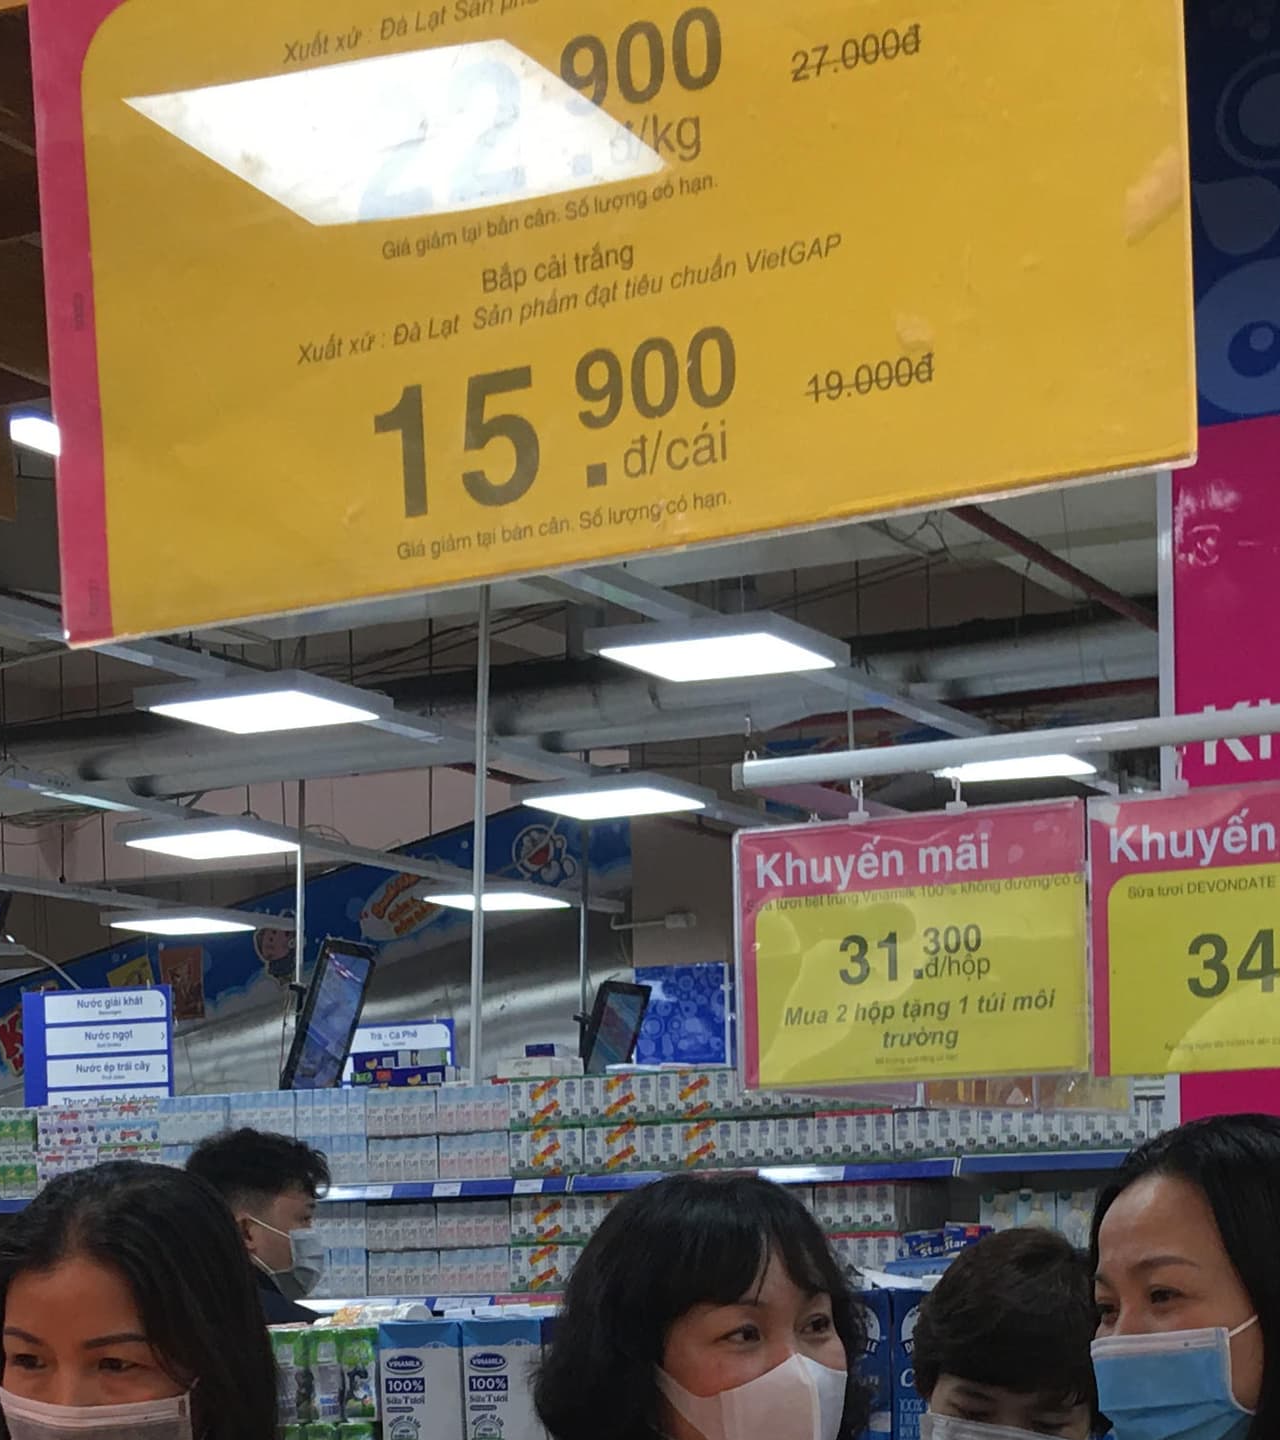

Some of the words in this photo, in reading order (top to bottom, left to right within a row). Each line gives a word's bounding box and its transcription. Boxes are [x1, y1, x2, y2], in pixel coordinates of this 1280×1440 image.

[560, 6, 722, 117] 900
[790, 22, 922, 84] 27.000đ
[382, 231, 412, 260] Giá
[415, 222, 458, 257] giảm
[564, 193, 589, 221] Số
[593, 185, 648, 218] lượng
[651, 180, 675, 202] có
[481, 260, 528, 294] Bắp
[533, 252, 568, 284] cải
[574, 240, 635, 280] trắng
[296, 332, 343, 366] Xuất
[348, 328, 376, 355] xứ
[393, 321, 421, 346] Đà
[428, 313, 461, 337] Lạt
[472, 300, 513, 331] Sản
[519, 288, 578, 324] phẩm
[584, 281, 618, 310] đạt
[624, 269, 662, 301] tiêu
[669, 252, 736, 291] chuẩn
[744, 234, 842, 273] VietGAP
[574, 325, 737, 430] 900
[804, 352, 935, 404] 19.000đ
[622, 418, 729, 479] đ/cái
[396, 535, 426, 562] Giá
[430, 528, 472, 560] giảm
[476, 526, 496, 551] tại
[578, 501, 604, 530] Số
[607, 499, 662, 531] lượng
[666, 492, 688, 516] có
[755, 835, 905, 890] Khuyến
[918, 831, 989, 873] mãi
[1108, 808, 1278, 871] Khuyến
[922, 924, 982, 956] 300
[924, 956, 991, 982] đ/hộp
[77, 998, 103, 1009] Nước
[784, 1007, 829, 1027] Mua
[836, 1004, 848, 1023] 2
[854, 1000, 895, 1025] hộp
[902, 997, 950, 1022] tặng
[959, 996, 969, 1015] 1
[977, 992, 1005, 1014] túi
[1012, 988, 1056, 1012] môi
[882, 1027, 960, 1050] trường
[387, 1380, 424, 1393] 100%
[471, 1378, 507, 1390] 100%
